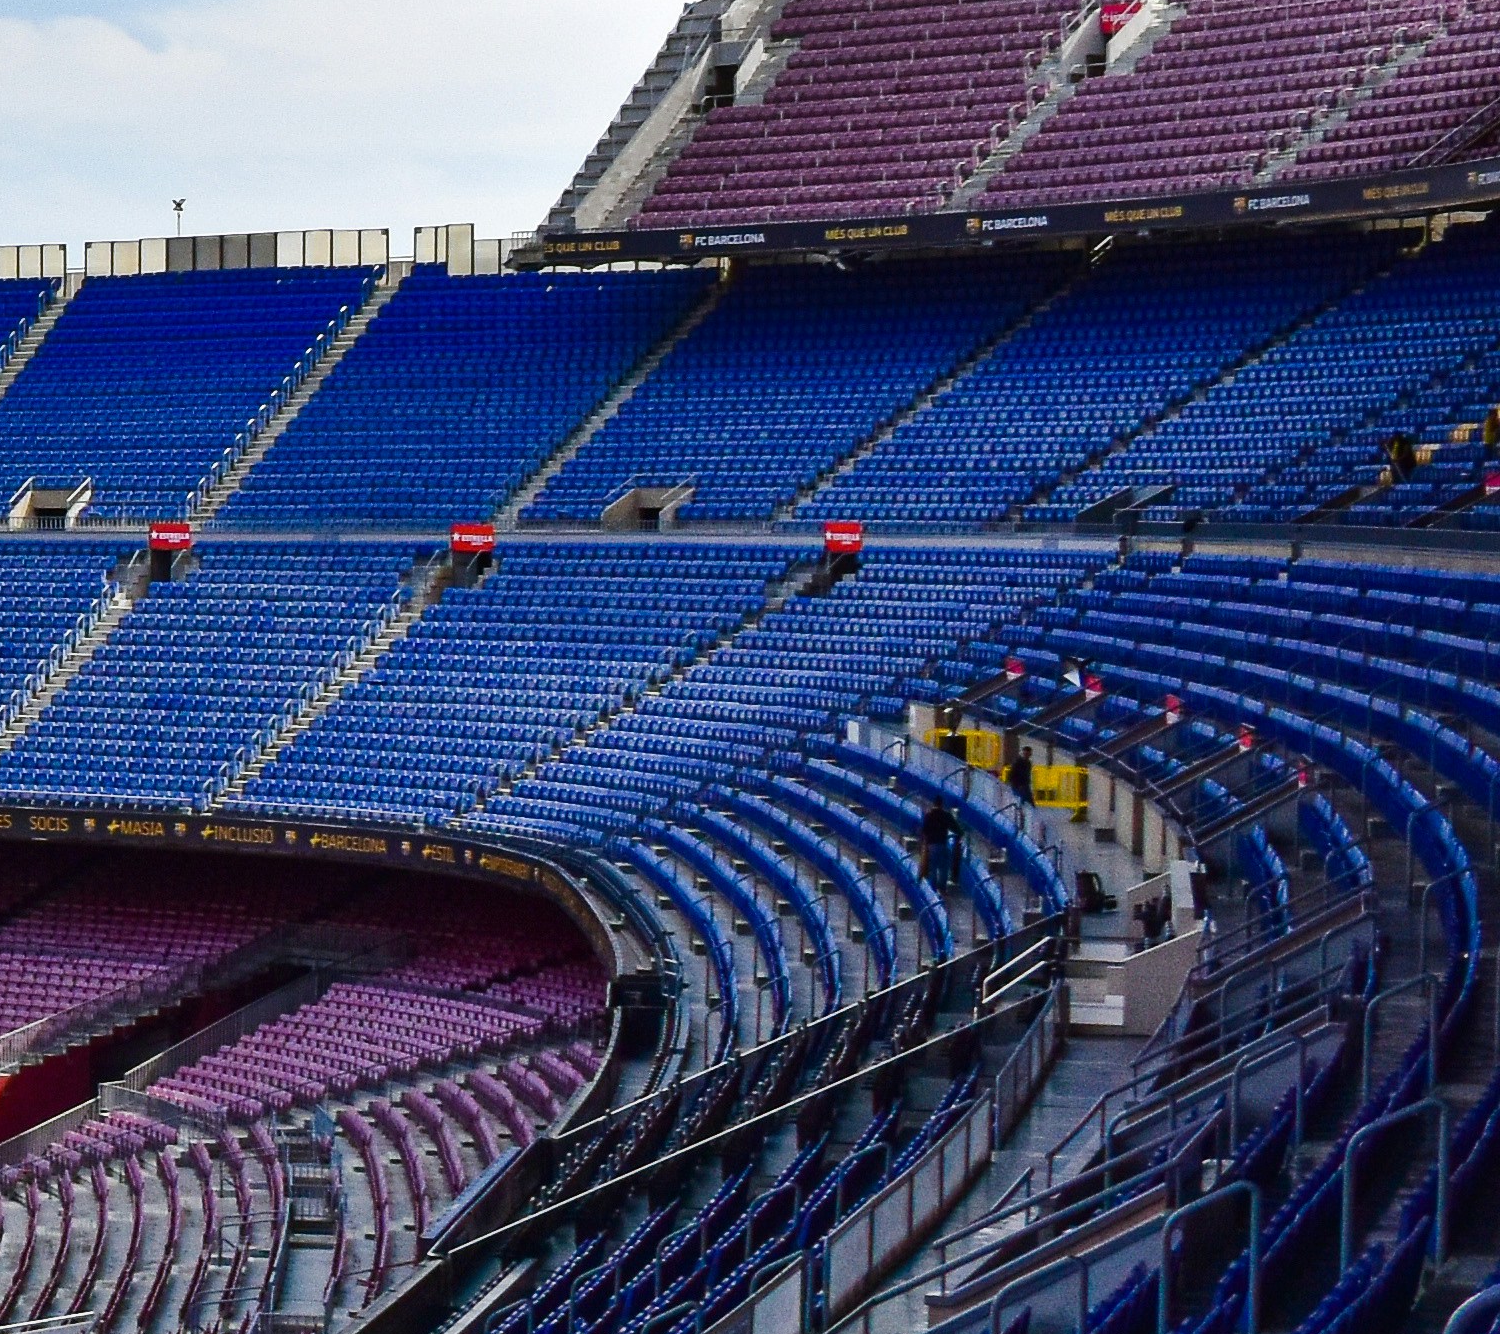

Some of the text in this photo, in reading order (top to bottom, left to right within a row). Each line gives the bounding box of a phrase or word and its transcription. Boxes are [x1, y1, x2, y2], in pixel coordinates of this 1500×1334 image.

[982, 216, 1048, 231] FC BARCELONA
[695, 233, 765, 246] FC BARCELONA
[825, 225, 908, 241] MÉS QUE UN CLUB
[556, 242, 576, 253] QUE
[594, 240, 620, 251] CLUB
